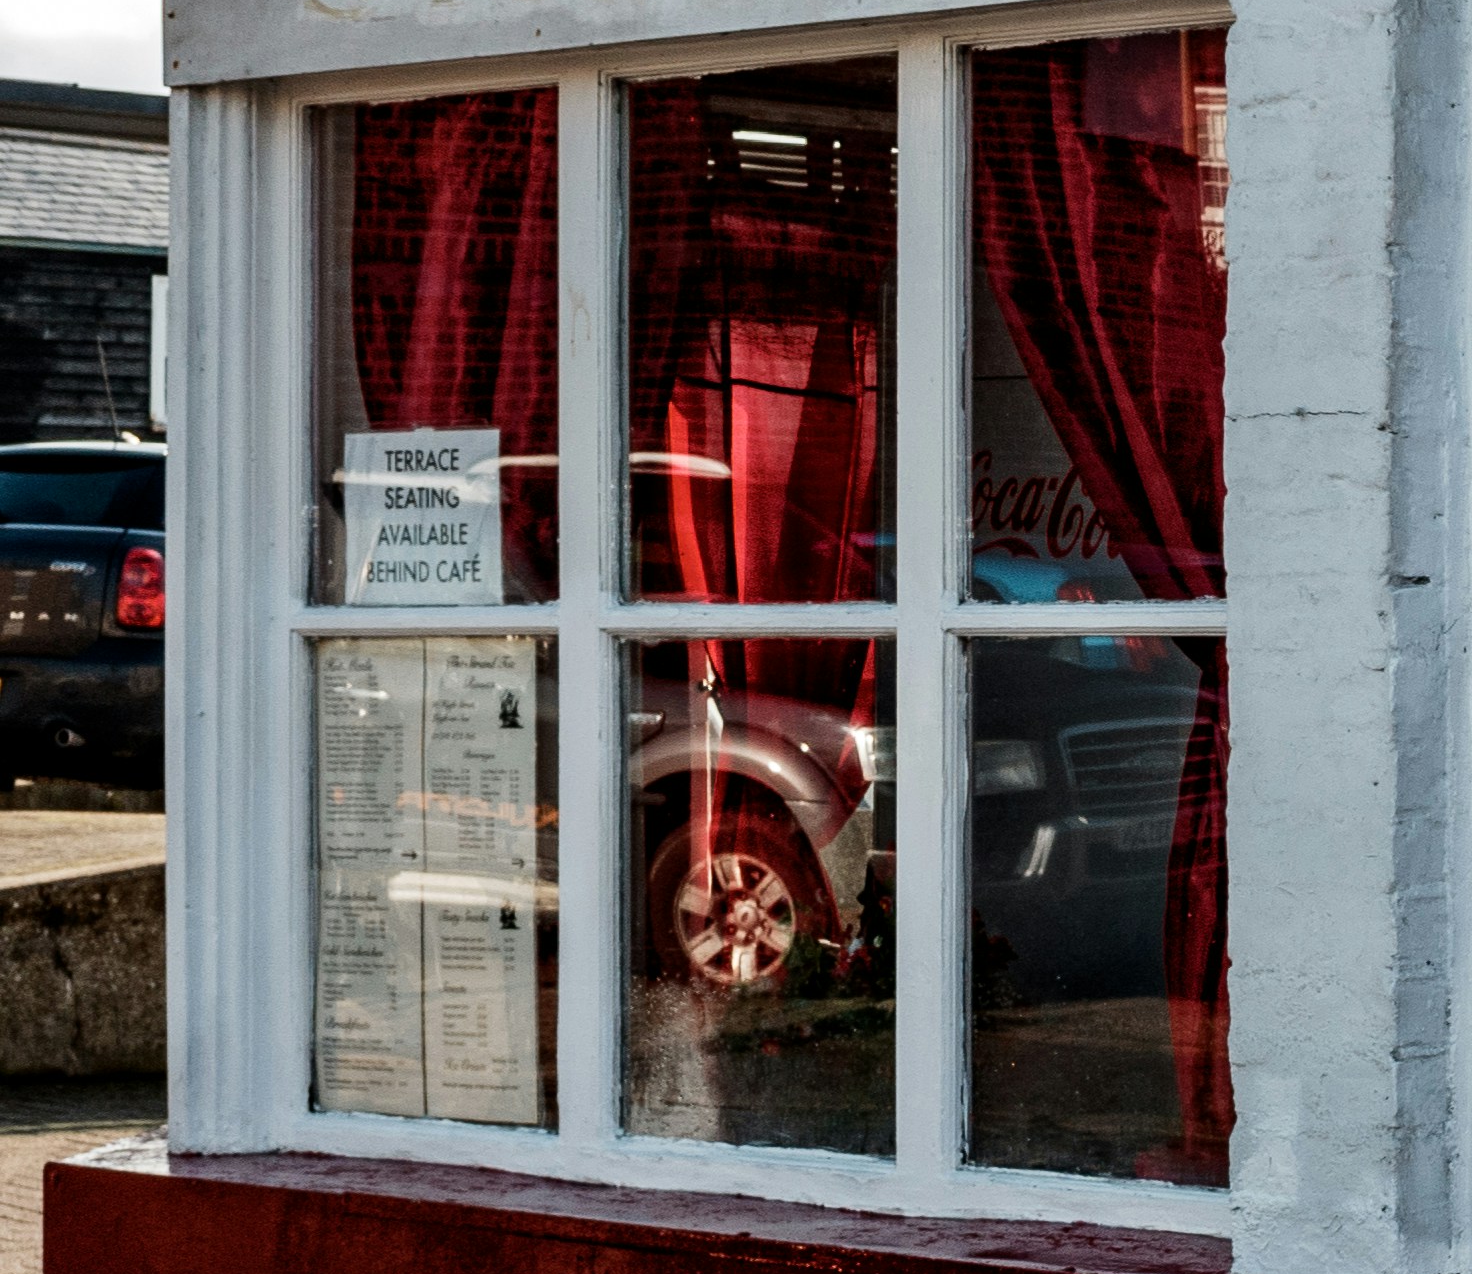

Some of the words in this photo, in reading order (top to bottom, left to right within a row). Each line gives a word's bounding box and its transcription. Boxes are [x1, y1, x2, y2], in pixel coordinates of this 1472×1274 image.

[384, 448, 460, 472] TERRACE
[384, 486, 461, 510] SEATING
[377, 523, 469, 546] AVAILABLE
[366, 560, 430, 583] BEHIND
[436, 553, 482, 583] CAFÉ
